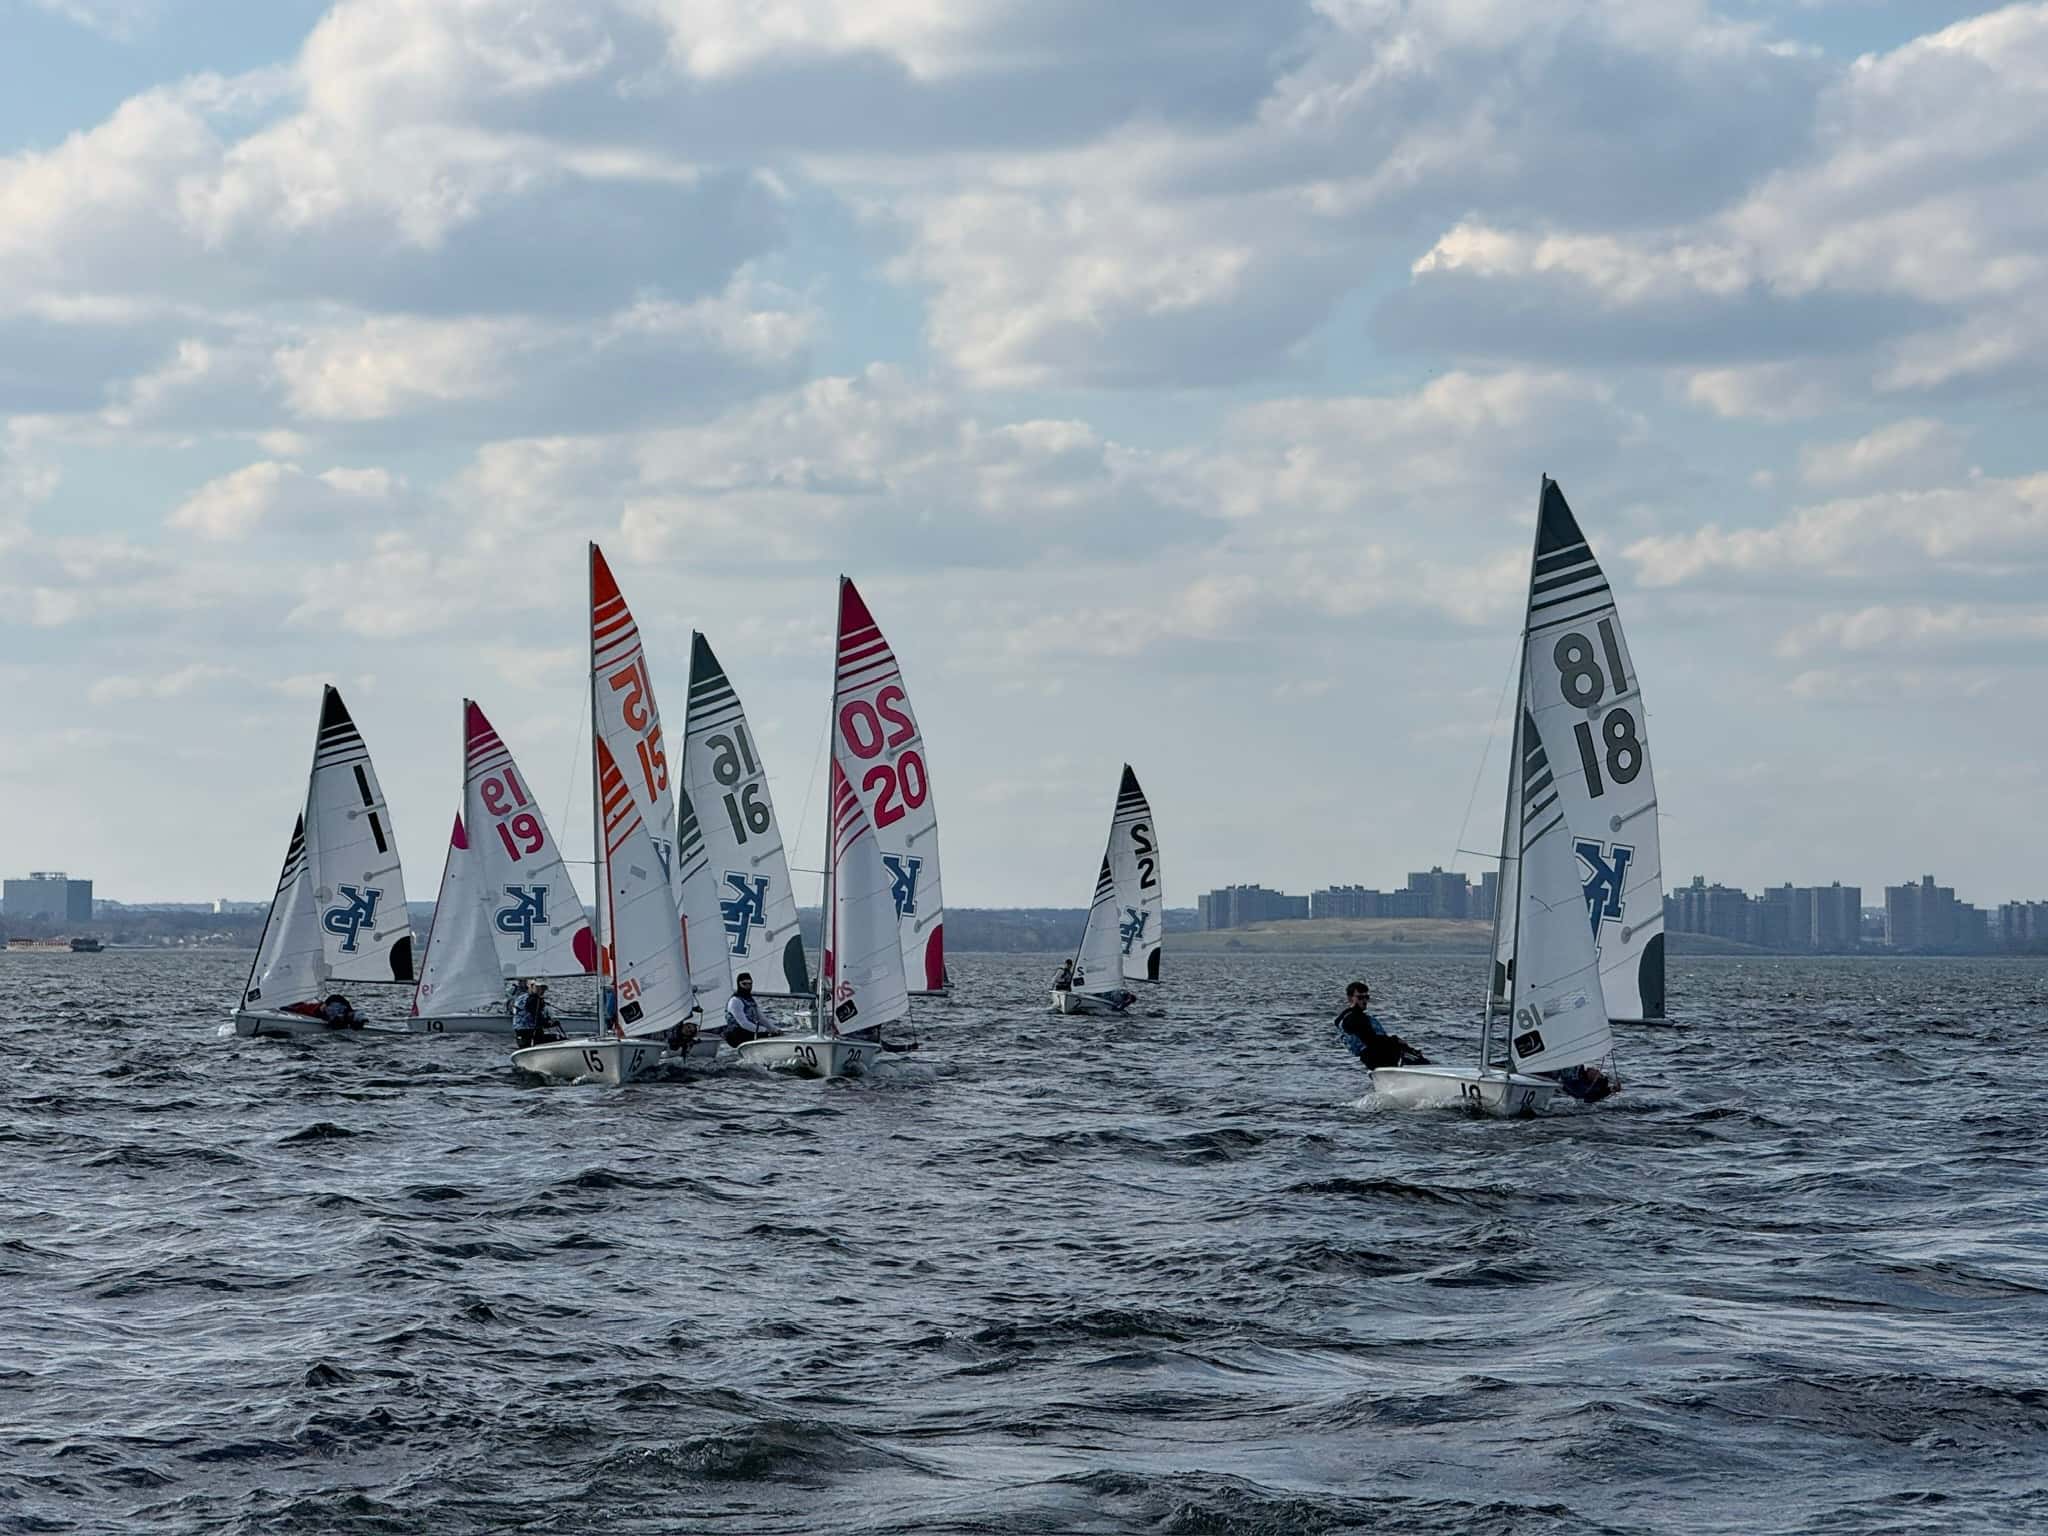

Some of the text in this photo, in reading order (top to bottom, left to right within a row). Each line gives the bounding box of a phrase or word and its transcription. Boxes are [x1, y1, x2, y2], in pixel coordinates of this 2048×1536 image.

[636, 724, 667, 804] 15
[1573, 708, 1642, 799] 18
[723, 783, 770, 845] 16
[862, 751, 927, 830] 20
[368, 811, 388, 854] 1
[496, 813, 544, 862] 19
[1137, 858, 1156, 889] 2
[582, 1049, 604, 1073] 15
[628, 1048, 645, 1072] 15
